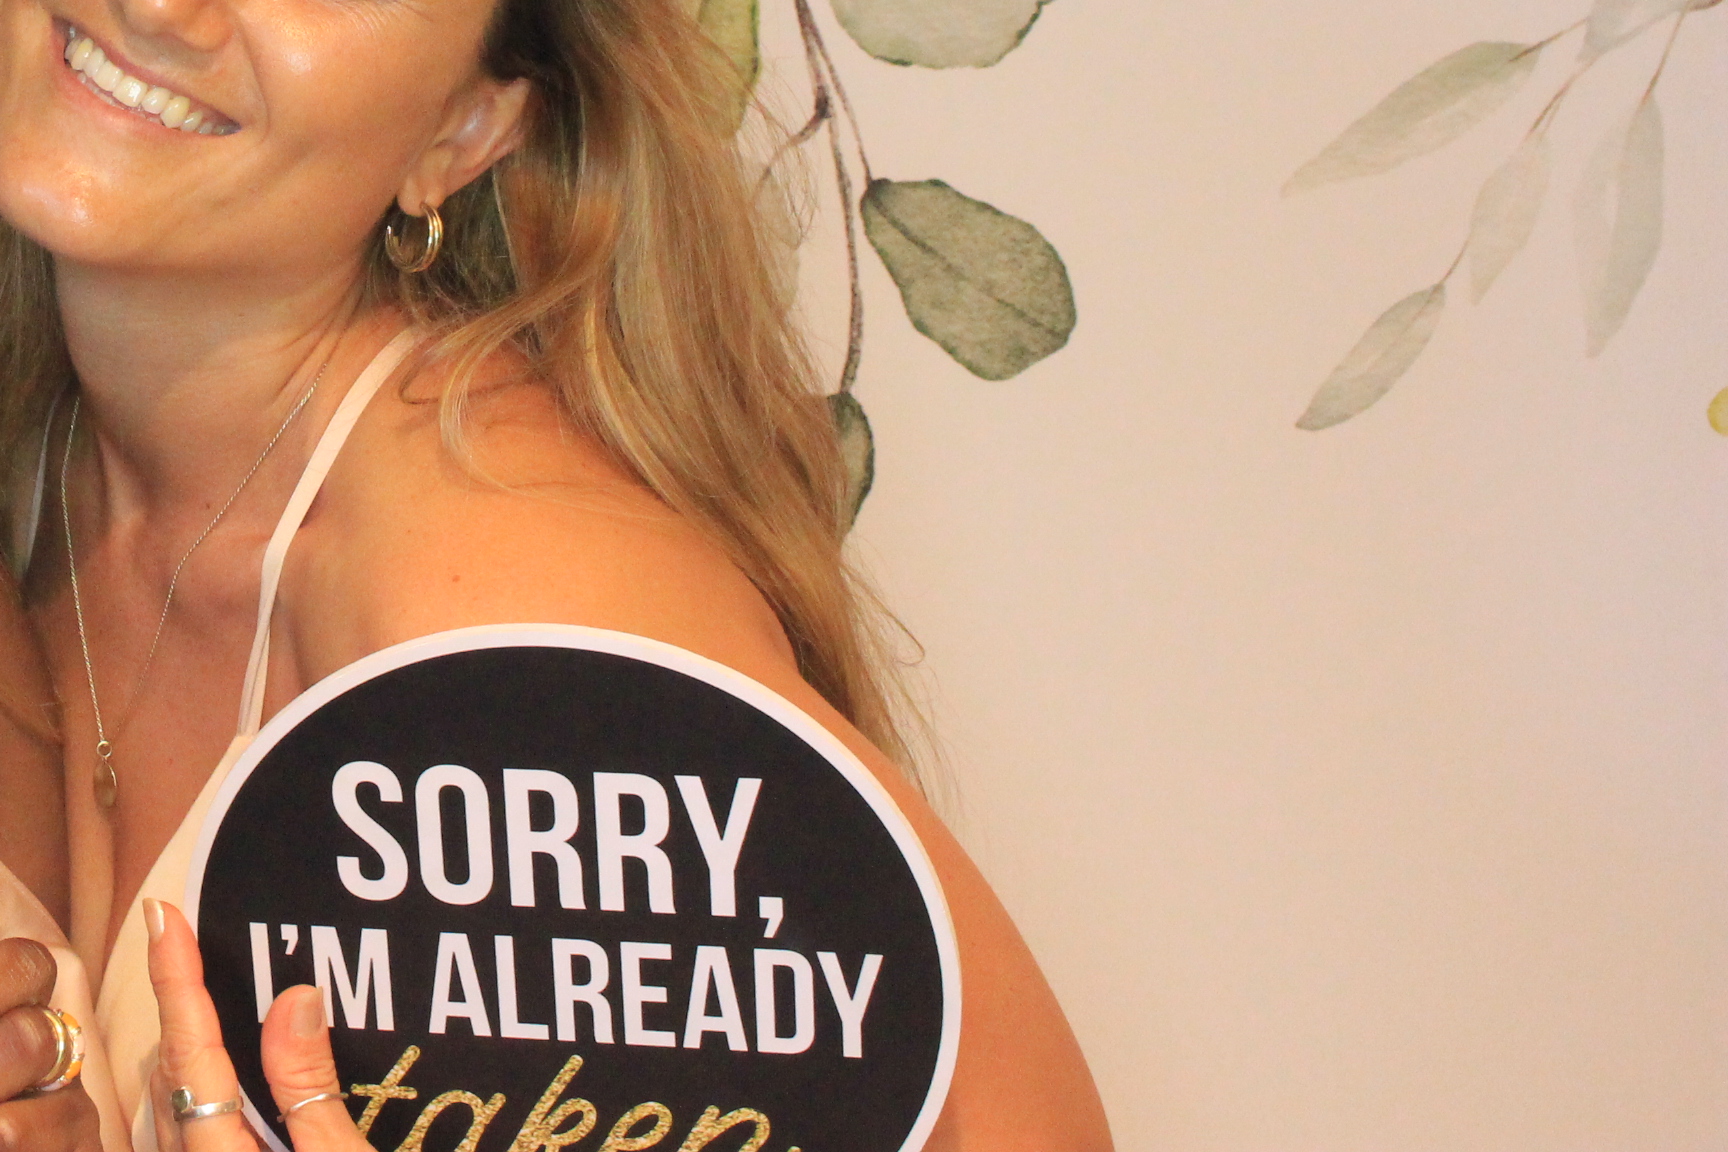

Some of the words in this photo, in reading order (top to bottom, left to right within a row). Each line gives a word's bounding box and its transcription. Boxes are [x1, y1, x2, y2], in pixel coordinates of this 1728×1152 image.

[331, 760, 784, 939] SORRY,
[249, 921, 395, 1032] I'M
[428, 932, 884, 1059] ALREADY
